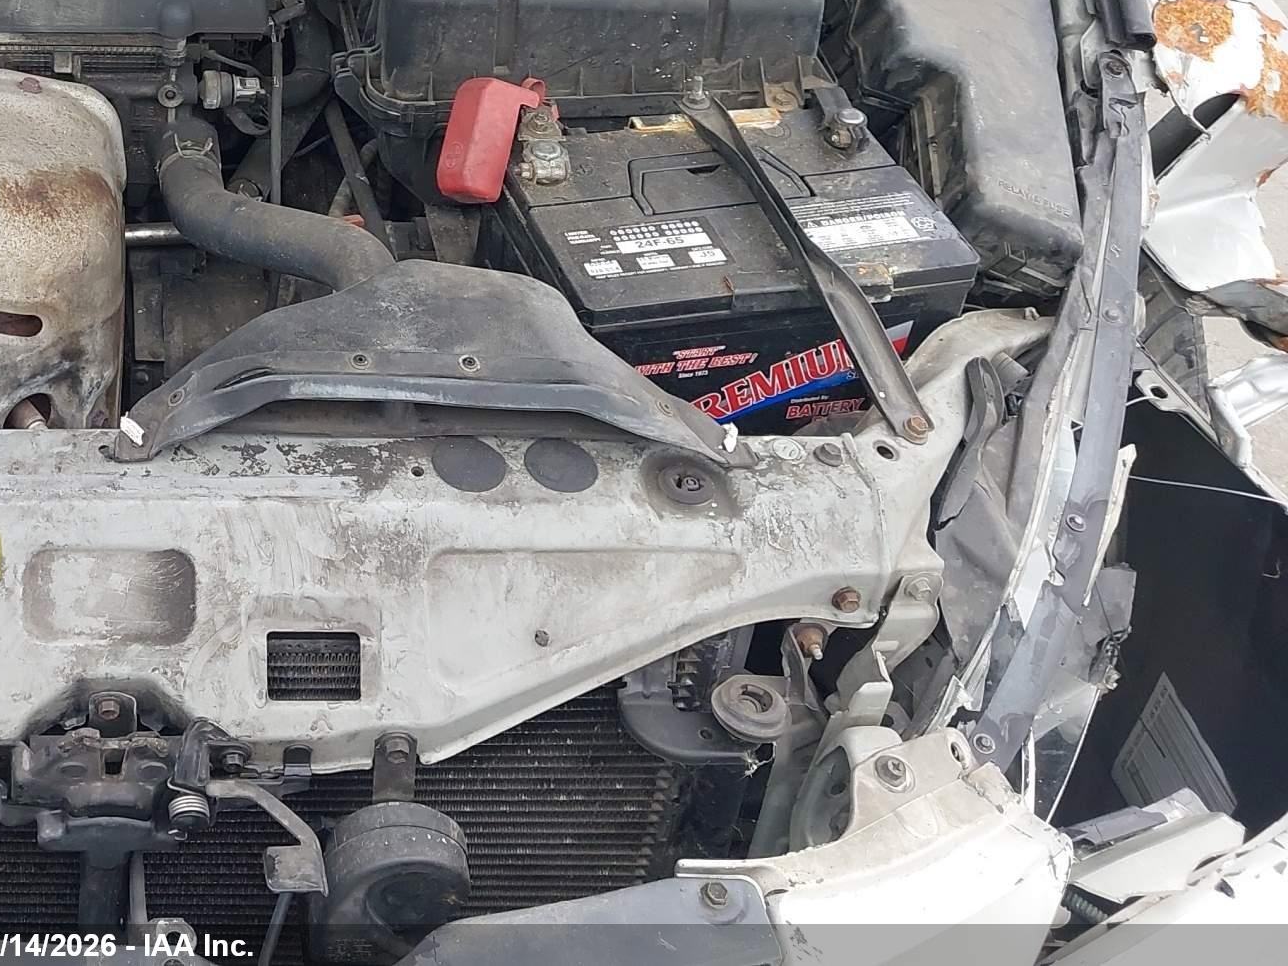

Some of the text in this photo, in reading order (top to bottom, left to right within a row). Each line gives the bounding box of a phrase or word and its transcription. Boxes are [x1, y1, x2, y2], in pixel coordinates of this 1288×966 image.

[635, 236, 685, 249] 24F-65
[676, 356, 708, 371] THE
[708, 351, 758, 368] BEST!
[691, 338, 855, 419] REMIU
[786, 397, 865, 419] BATTERY
